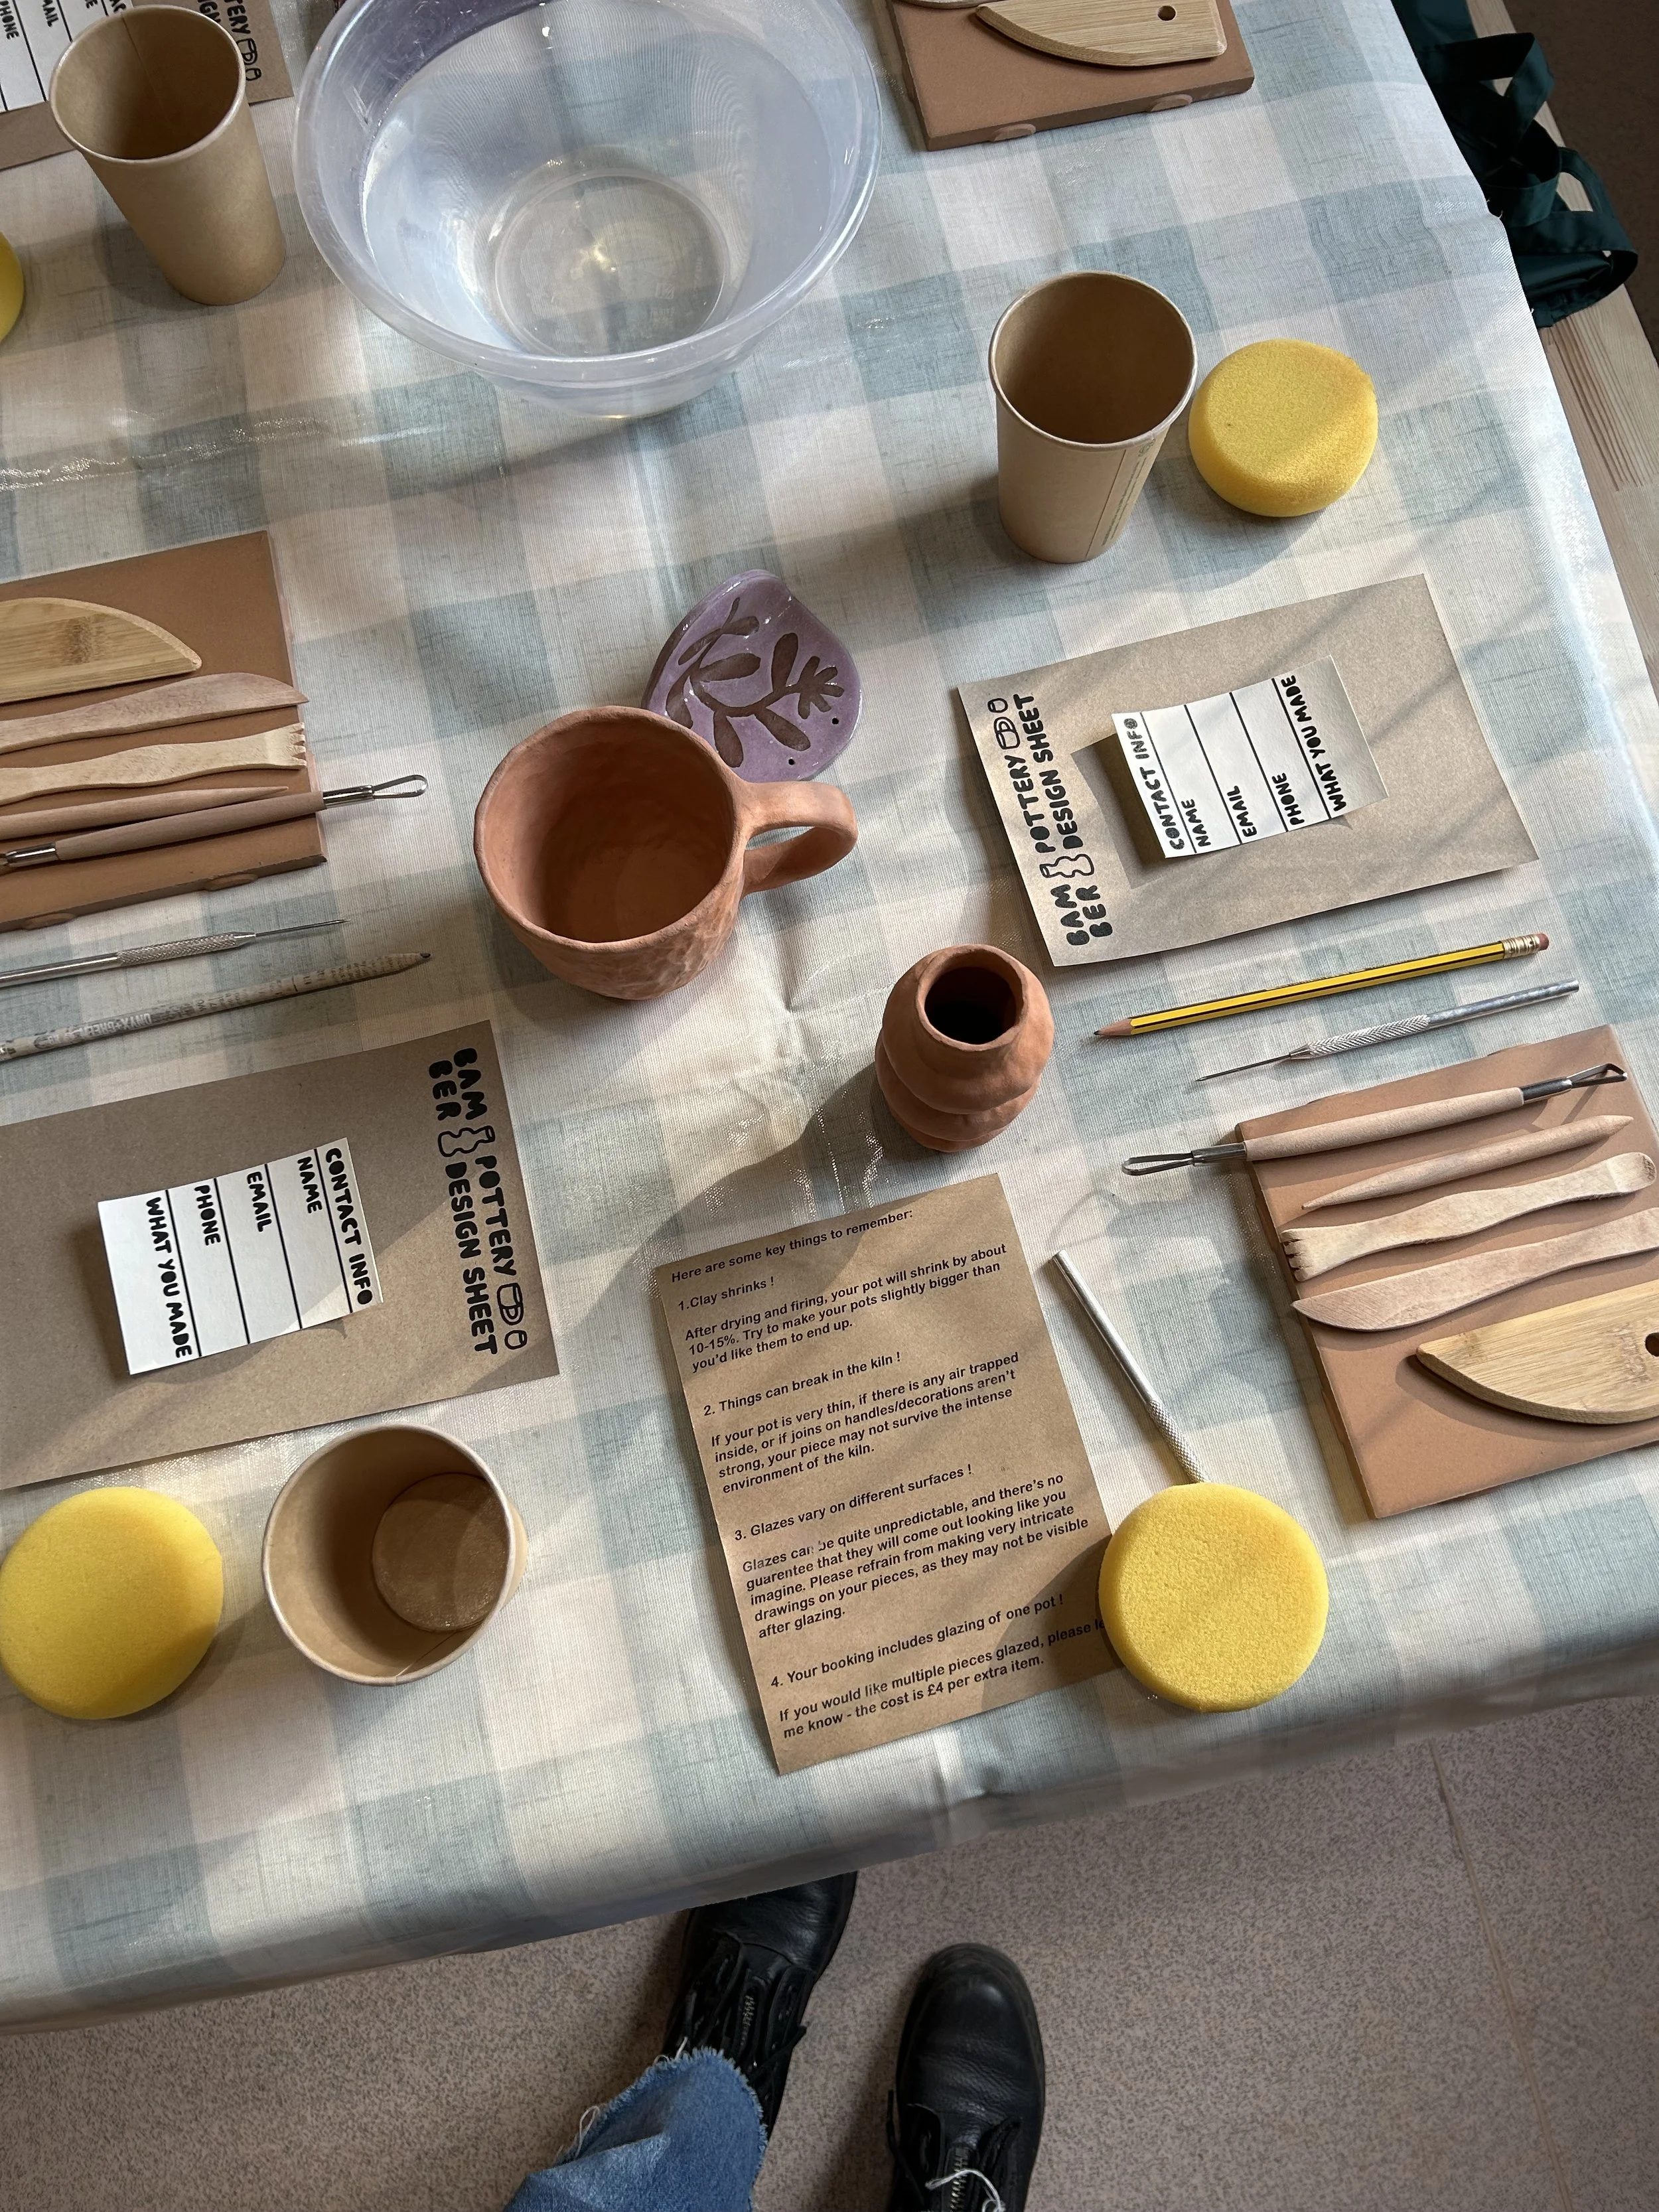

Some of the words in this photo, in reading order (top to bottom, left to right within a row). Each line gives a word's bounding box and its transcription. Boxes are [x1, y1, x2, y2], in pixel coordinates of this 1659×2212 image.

[42, 0, 58, 27] MAIL
[1013, 695, 1054, 763] SHEET
[1280, 675, 1313, 723] MADE
[1123, 717, 1150, 760] INFO
[1301, 725, 1326, 759] YOU
[1007, 757, 1056, 853] POTTERY
[1041, 769, 1084, 850] DESIGN
[1139, 768, 1185, 850] CONTACT
[1226, 785, 1258, 838] EMAIL
[1271, 773, 1305, 826] PHONE
[1315, 763, 1347, 812] WHAT
[1181, 798, 1212, 848] NAME
[1050, 884, 1090, 946] BAM
[1075, 885, 1114, 938] BER
[428, 1060, 462, 1121] BER
[449, 1047, 488, 1120] BAM
[194, 1185, 221, 1246] PHONE
[246, 1171, 272, 1232] EMAIL
[297, 1156, 323, 1214] NAME
[445, 1161, 482, 1259] DESIGN
[474, 1155, 517, 1276] POTTERY
[145, 1197, 172, 1254] WHAT
[325, 1147, 362, 1246] CONTACT
[348, 1253, 373, 1305] INFO
[671, 1267, 701, 1283] Here
[704, 1260, 725, 1273] are
[728, 1250, 762, 1267] some
[764, 1244, 786, 1257] key
[788, 1233, 828, 1250] things
[845, 1209, 913, 1236] remember:
[157, 1258, 180, 1297] YOU
[463, 1267, 498, 1355] SHEET
[684, 1324, 718, 1341] After
[720, 1312, 761, 1331] drying
[764, 1302, 788, 1319] and
[790, 1295, 828, 1312] firing,
[830, 1284, 859, 1303] your
[861, 1276, 883, 1294] pot
[885, 1269, 907, 1285] will
[909, 1258, 950, 1278] shrink
[970, 1242, 1007, 1262] about
[688, 1333, 739, 1355] 10-15%.
[741, 1327, 763, 1341] Try
[782, 1313, 816, 1330] make
[818, 1303, 847, 1322] your
[849, 1295, 877, 1313] pots
[880, 1282, 926, 1302] slightly
[928, 1270, 970, 1290] bigger
[972, 1262, 1000, 1277] than
[720, 1280, 767, 1299] shrinks
[165, 1302, 192, 1359] MADE
[691, 1351, 727, 1374] you'd
[730, 1347, 753, 1360] like
[755, 1337, 787, 1353] them
[806, 1321, 830, 1339] end
[833, 1319, 853, 1331] up.
[703, 1404, 715, 1416] 2.
[718, 1392, 762, 1412] Things
[764, 1384, 789, 1398] can
[791, 1371, 829, 1392] break
[846, 1363, 867, 1376] the
[870, 1355, 893, 1369] kiln
[714, 1443, 758, 1463] inside,
[790, 1424, 822, 1444] joins
[844, 1382, 974, 1426] handles/decorations
[976, 1368, 1016, 1389] aren't
[724, 1426, 754, 1446] your
[757, 1418, 779, 1437] pot
[795, 1407, 823, 1423] very
[826, 1399, 855, 1414] thin,
[871, 1384, 905, 1402] there
[922, 1373, 945, 1387] any
[948, 1366, 966, 1380] air
[968, 1351, 1019, 1374] trapped
[718, 1458, 764, 1478] strong,
[766, 1448, 797, 1467] your
[800, 1438, 835, 1458] piece
[838, 1428, 865, 1444] may
[868, 1420, 890, 1436] not
[891, 1408, 938, 1429] survive
[940, 1402, 962, 1415] the
[965, 1388, 1013, 1409] intense
[722, 1461, 804, 1493] environment
[823, 1451, 844, 1465] the
[847, 1443, 875, 1458] kiln.
[734, 1528, 747, 1541] 3.
[750, 1516, 795, 1536] Glazes
[797, 1507, 826, 1522] vary
[848, 1482, 905, 1509] different
[907, 1468, 964, 1491] surfaces
[742, 1552, 787, 1572] Glazes
[837, 1528, 871, 1547] quite
[873, 1501, 968, 1535] unpredictable,
[971, 1490, 995, 1507] and
[998, 1479, 1045, 1500] there's
[1046, 1474, 1064, 1487] no
[745, 1562, 814, 1592] guarentee
[816, 1551, 844, 1569] that
[845, 1544, 873, 1560] they
[876, 1534, 899, 1552] will
[902, 1526, 938, 1544] come
[941, 1516, 964, 1532] out
[965, 1505, 1014, 1526] looking
[1016, 1498, 1040, 1512] like
[1042, 1490, 1066, 1508] you
[750, 1583, 806, 1606] imagine.
[809, 1568, 853, 1589] Please
[856, 1554, 901, 1575] refrain
[902, 1544, 934, 1562] from
[936, 1530, 985, 1552] making
[987, 1520, 1016, 1537] very
[1019, 1505, 1074, 1528] intricate
[754, 1596, 816, 1621] drawings
[837, 1581, 868, 1601] your
[871, 1568, 918, 1591] pieces,
[940, 1552, 968, 1568] they
[972, 1543, 999, 1560] may
[1001, 1534, 1025, 1551] not
[1025, 1531, 1043, 1544] be
[1045, 1517, 1088, 1538] visible
[758, 1621, 791, 1639] after
[794, 1606, 845, 1631] glazing.
[770, 1675, 784, 1688] 4.
[786, 1666, 818, 1683] Your
[820, 1650, 874, 1674] booking
[877, 1633, 934, 1657] includes
[936, 1617, 985, 1643] glazing
[1005, 1605, 1031, 1619] one
[1033, 1595, 1056, 1615] pot
[783, 1725, 804, 1739] me
[807, 1712, 843, 1732] know
[854, 1703, 877, 1718] the
[879, 1691, 910, 1710] cost
[926, 1680, 944, 1697] £4
[947, 1675, 970, 1694] per
[973, 1665, 1008, 1682] extra
[1010, 1655, 1044, 1672] item.
[793, 1702, 818, 1721] you
[820, 1686, 861, 1710] would
[864, 1682, 888, 1697] like
[891, 1664, 945, 1689] multiple
[948, 1651, 993, 1676] pieces
[995, 1635, 1044, 1661] glazed,
[1046, 1623, 1092, 1647] please
[1094, 1619, 1105, 1631] le
